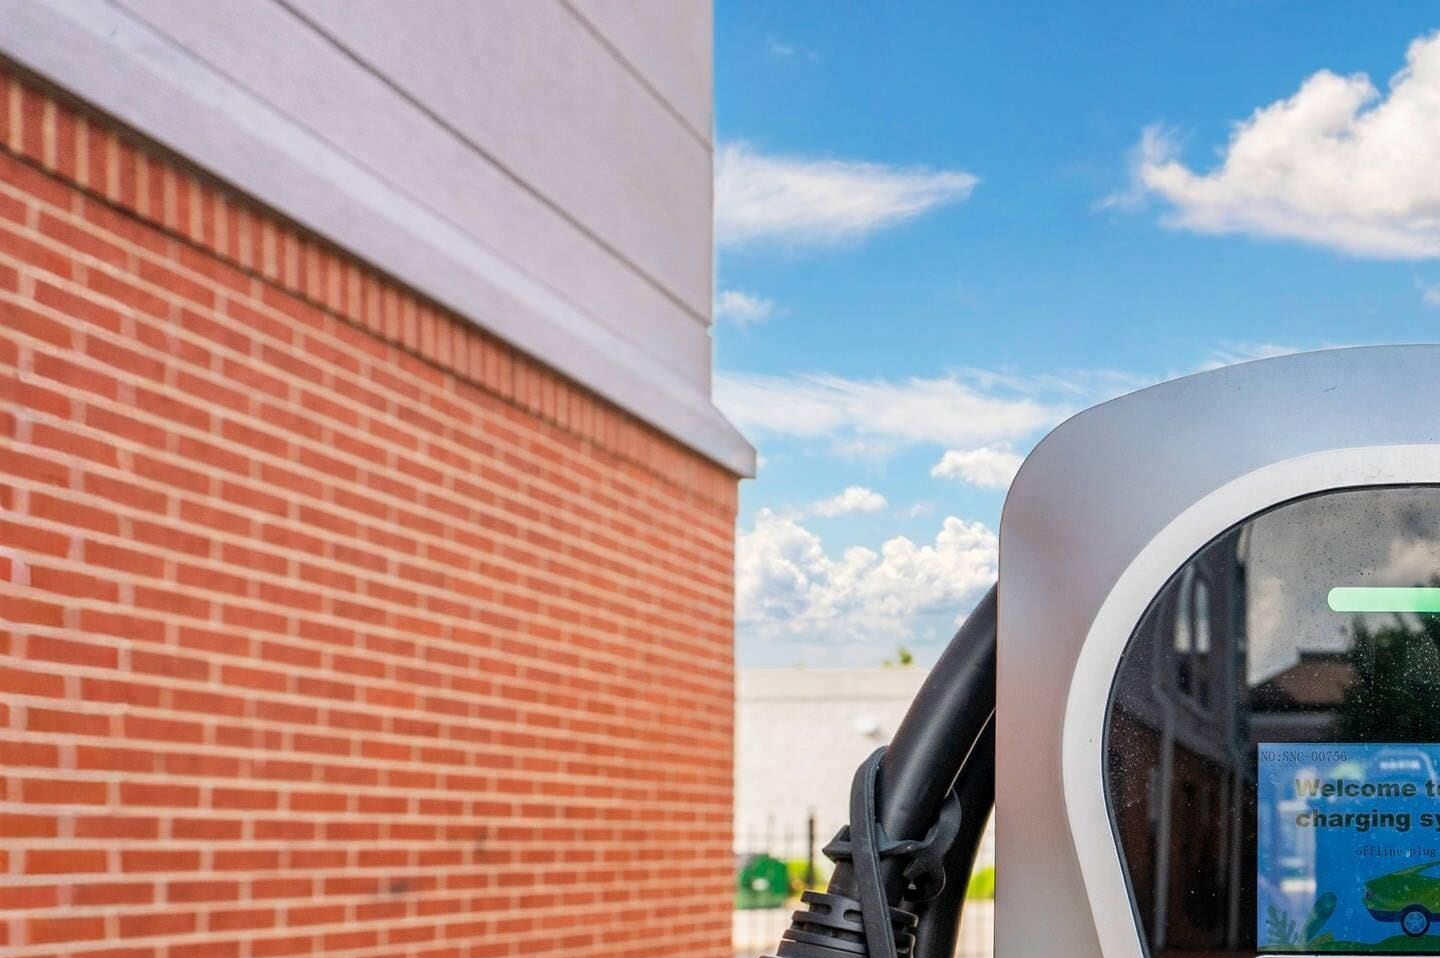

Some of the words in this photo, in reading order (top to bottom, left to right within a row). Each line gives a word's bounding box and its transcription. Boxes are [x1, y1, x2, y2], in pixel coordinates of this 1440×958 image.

[1296, 778, 1416, 797] Welcome
[1295, 809, 1411, 832] charging
[1355, 846, 1401, 857] offline
[1409, 846, 1437, 857] plug
